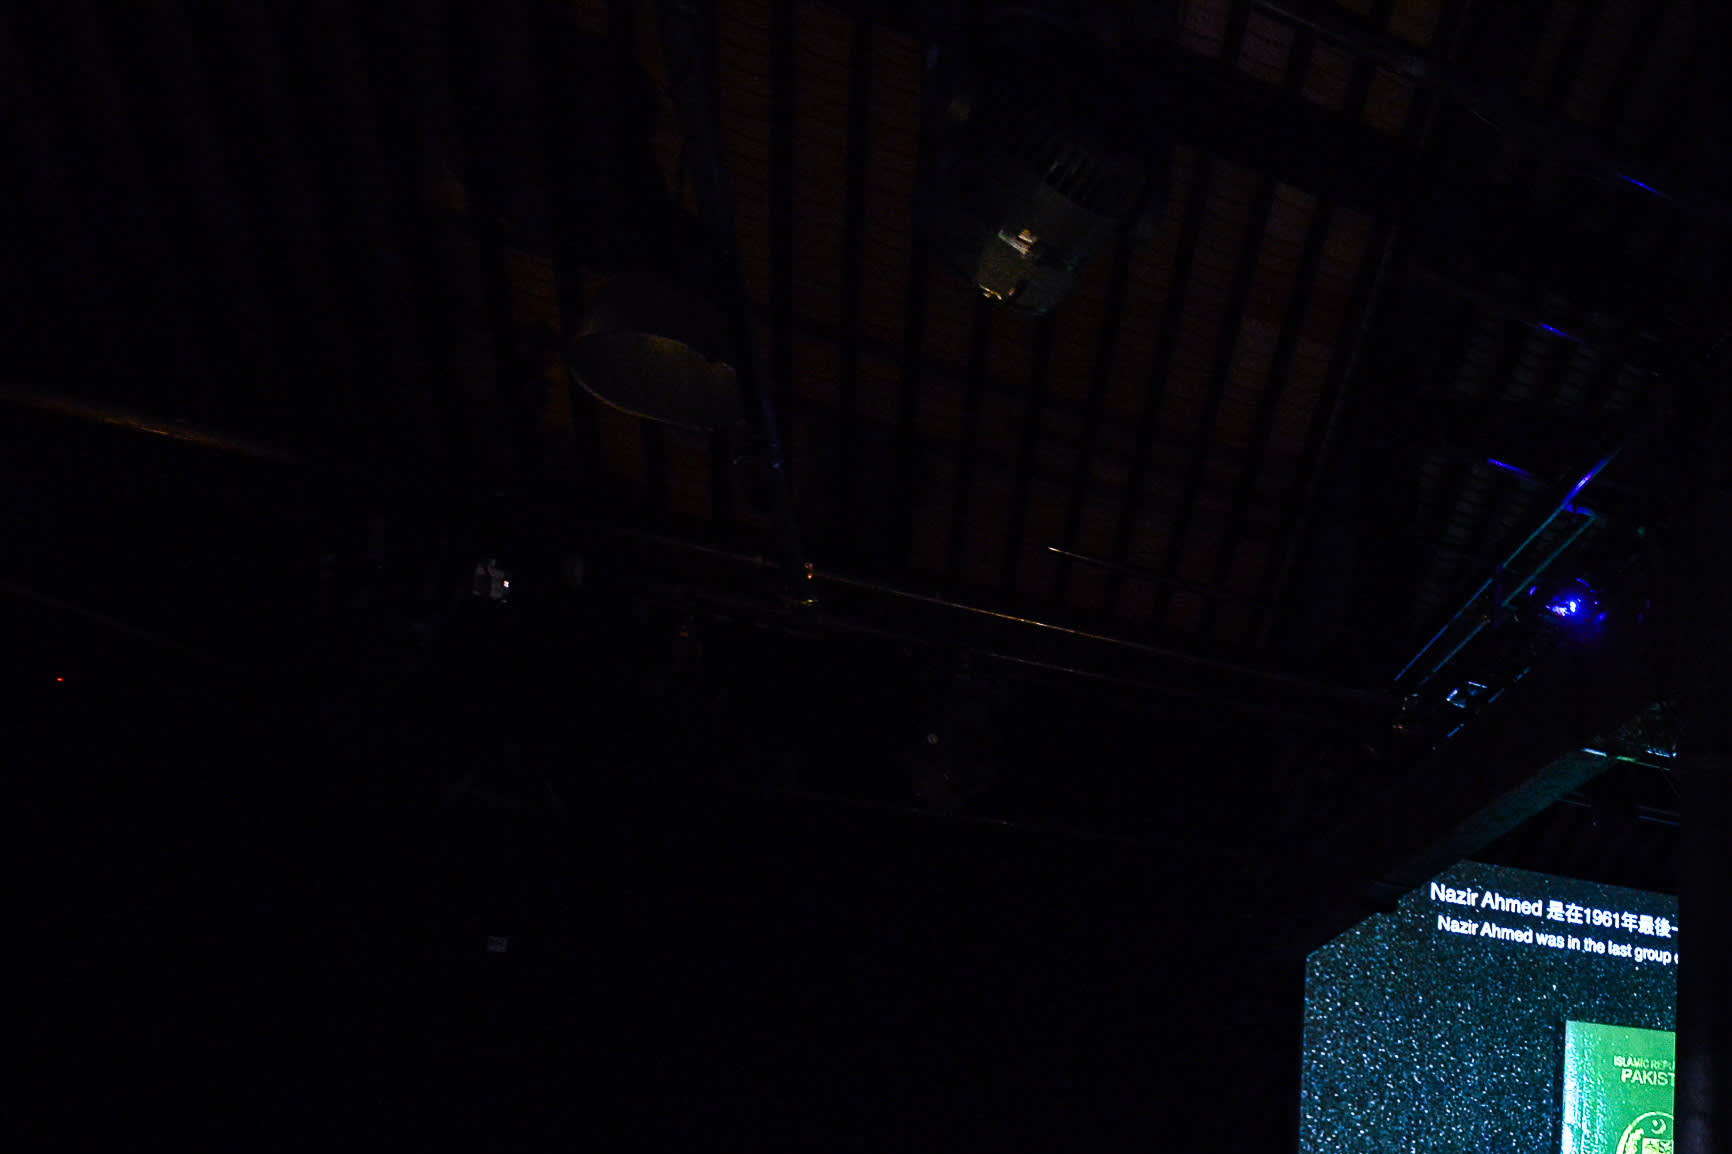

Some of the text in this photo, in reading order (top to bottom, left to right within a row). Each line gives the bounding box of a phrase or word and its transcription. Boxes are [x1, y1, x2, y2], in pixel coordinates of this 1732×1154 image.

[1430, 881, 1479, 907] Nazir
[1480, 890, 1543, 917] Ahmed
[1437, 914, 1479, 936] Nazir
[1480, 921, 1534, 944] Ahmed
[1535, 932, 1566, 949] was
[1567, 934, 1581, 951] in
[1583, 937, 1606, 954] the
[1608, 939, 1633, 958] last
[1634, 946, 1672, 966] group
[1621, 1068, 1676, 1088] PAKIST
